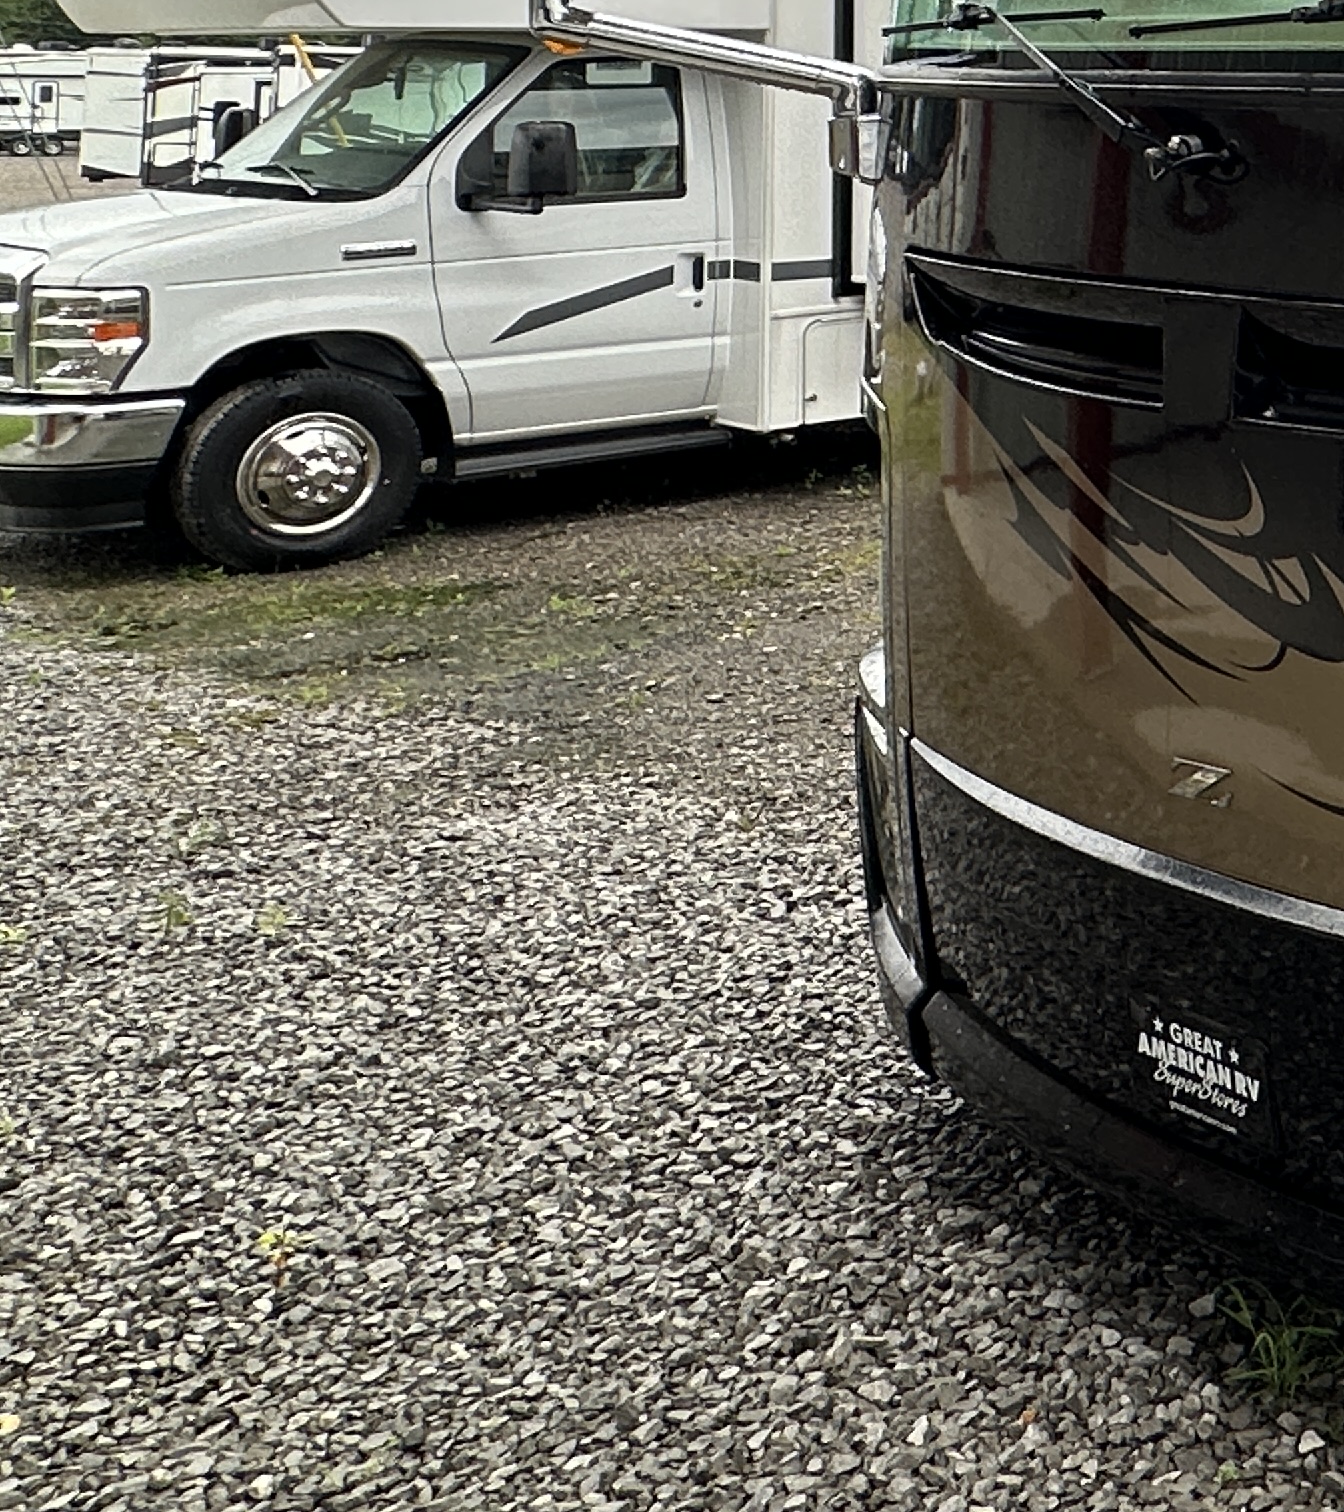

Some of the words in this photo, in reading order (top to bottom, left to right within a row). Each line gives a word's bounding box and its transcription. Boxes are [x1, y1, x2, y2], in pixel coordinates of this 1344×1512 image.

[1137, 1031, 1232, 1090] AMERICAN
[1234, 1070, 1260, 1102] RV
[1168, 1022, 1223, 1061] GREAT
